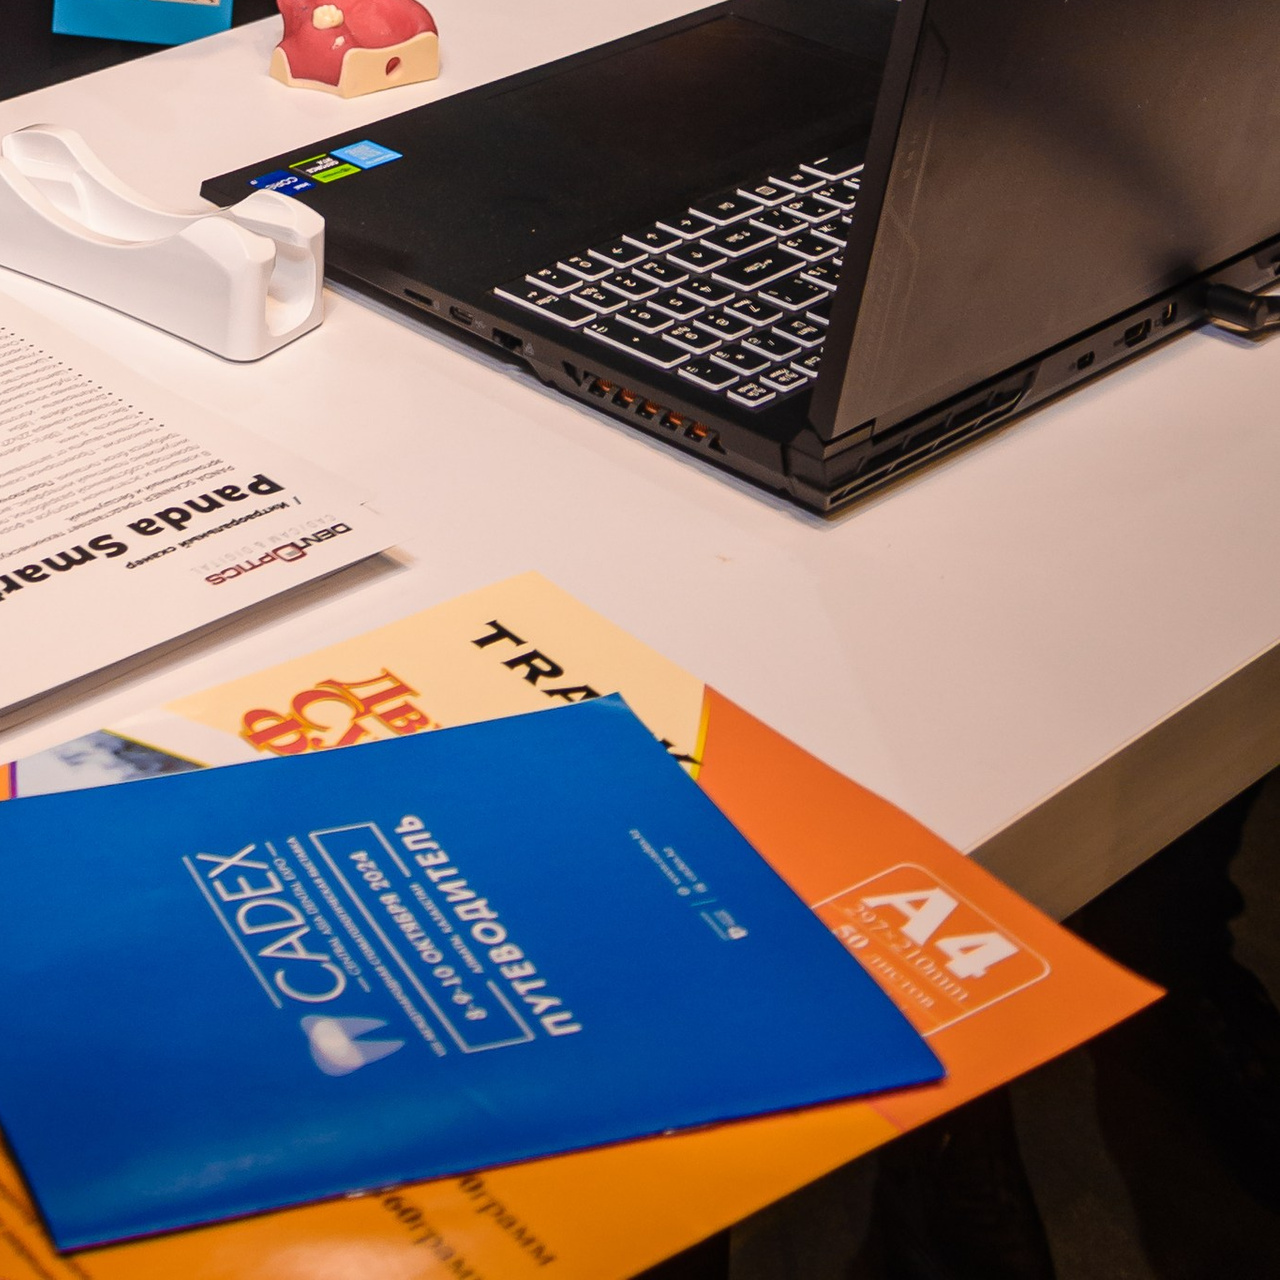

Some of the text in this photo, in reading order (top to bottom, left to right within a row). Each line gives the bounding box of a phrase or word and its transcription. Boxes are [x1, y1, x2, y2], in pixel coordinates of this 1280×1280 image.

[126, 473, 286, 539] Panda
[173, 498, 293, 550] Интраоральный
[119, 543, 181, 572] сканер
[203, 520, 354, 588] DENTOPTICS
[193, 842, 358, 1008] CADEX
[345, 849, 490, 1021] 8-9-10 ОКТЯБРЯ 2024
[384, 812, 589, 1037] ПУТЕВОДИТЕЛЬ
[860, 887, 1021, 981] A4
